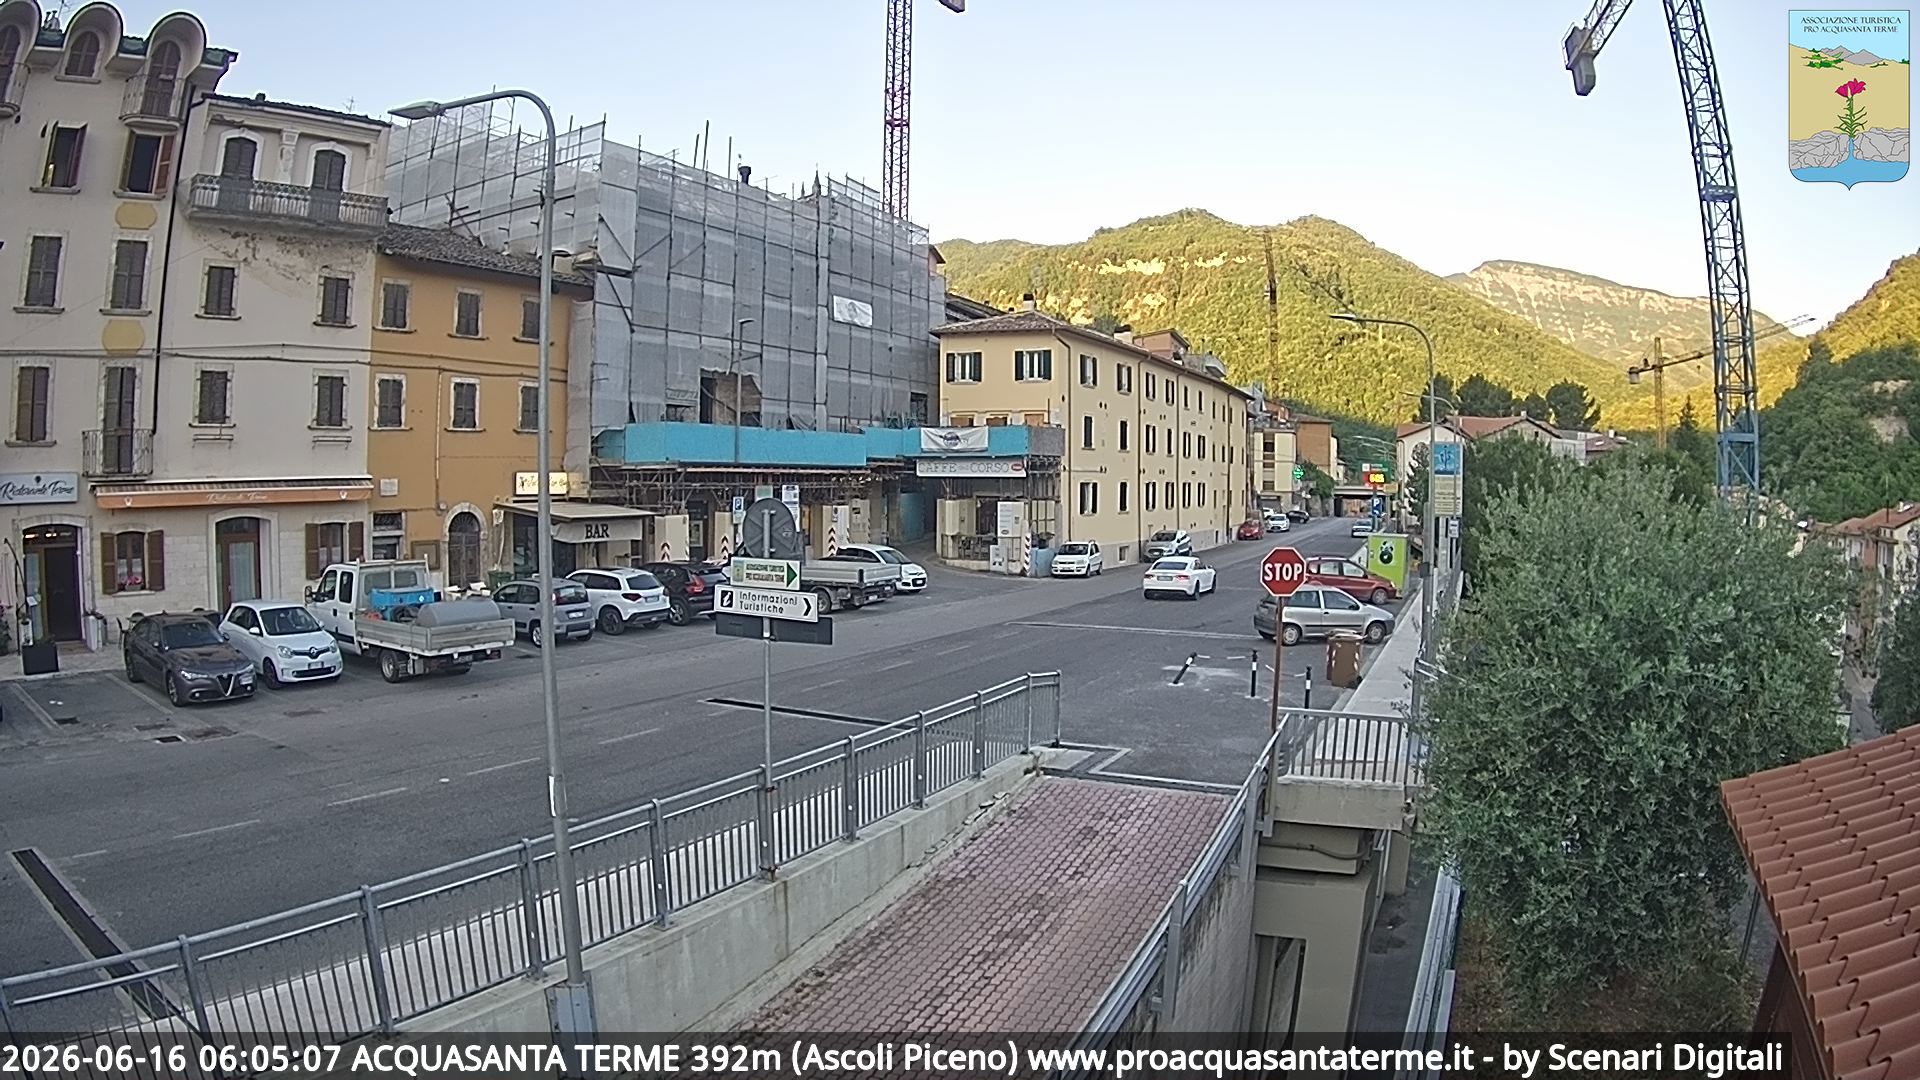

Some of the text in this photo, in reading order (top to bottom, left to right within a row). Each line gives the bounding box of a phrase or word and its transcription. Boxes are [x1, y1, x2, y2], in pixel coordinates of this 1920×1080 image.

[970, 463, 1009, 473] CORSO
[1373, 498, 1380, 507] P
[585, 524, 610, 539] BAR
[1264, 562, 1303, 581] STOP
[740, 592, 798, 605] Informazioni
[740, 601, 784, 613] Turistiche
